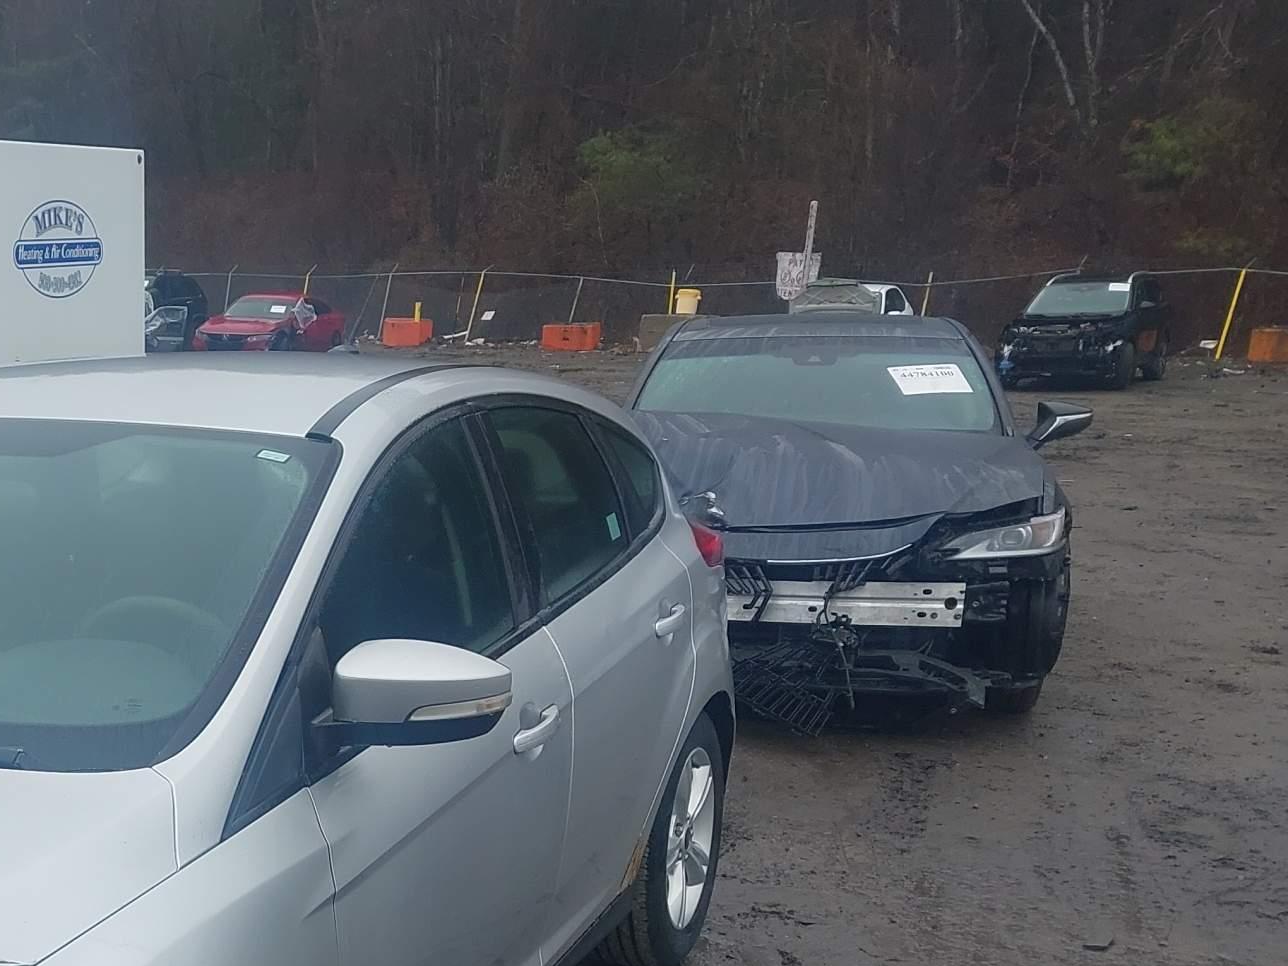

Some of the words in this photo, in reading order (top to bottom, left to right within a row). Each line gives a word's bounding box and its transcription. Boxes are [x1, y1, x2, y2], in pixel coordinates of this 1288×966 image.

[33, 206, 84, 237] MIKE'S
[17, 243, 43, 264] Heating
[44, 246, 50, 259] &
[51, 244, 61, 259] Air
[61, 242, 100, 260] Conditioning
